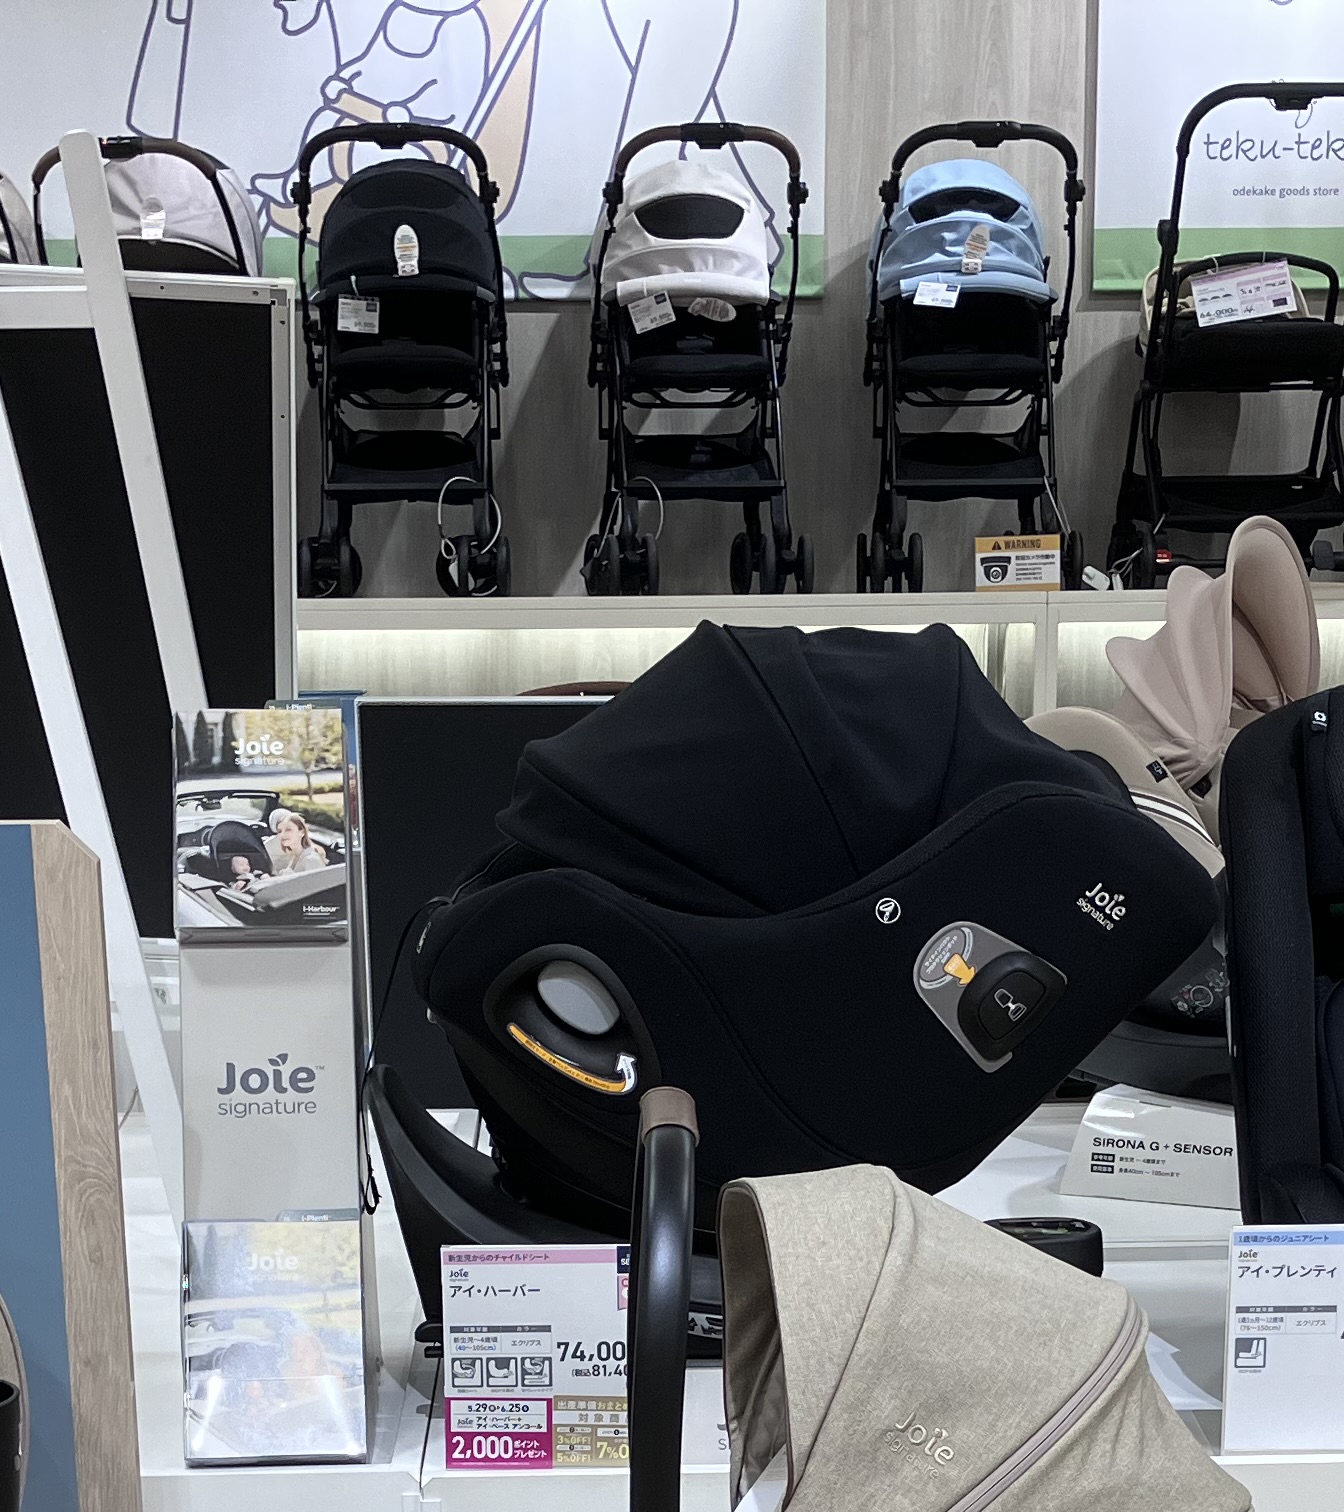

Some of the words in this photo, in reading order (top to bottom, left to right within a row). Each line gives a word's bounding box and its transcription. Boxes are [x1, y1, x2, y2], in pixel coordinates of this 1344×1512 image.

[1232, 185, 1276, 197] odekake
[1279, 185, 1310, 198] goods
[1313, 187, 1340, 197] store
[1004, 539, 1041, 550] WARNING
[234, 733, 284, 756] Joie
[1085, 882, 1126, 920] Joie
[1076, 897, 1114, 930] signature
[217, 1053, 316, 1095] Joie
[218, 1098, 317, 1118] signature
[1092, 1136, 1146, 1151] SIRONA
[1149, 1141, 1160, 1151] G
[1172, 1142, 1234, 1157] SENSOR
[248, 1248, 299, 1271] Joie
[1237, 1249, 1258, 1259] Joie
[449, 1268, 469, 1278] Joie
[449, 1284, 541, 1298] アイ・ハーバー
[556, 1341, 626, 1362] 74,00
[451, 1435, 513, 1459] 2,000
[894, 1411, 955, 1466] Joie
